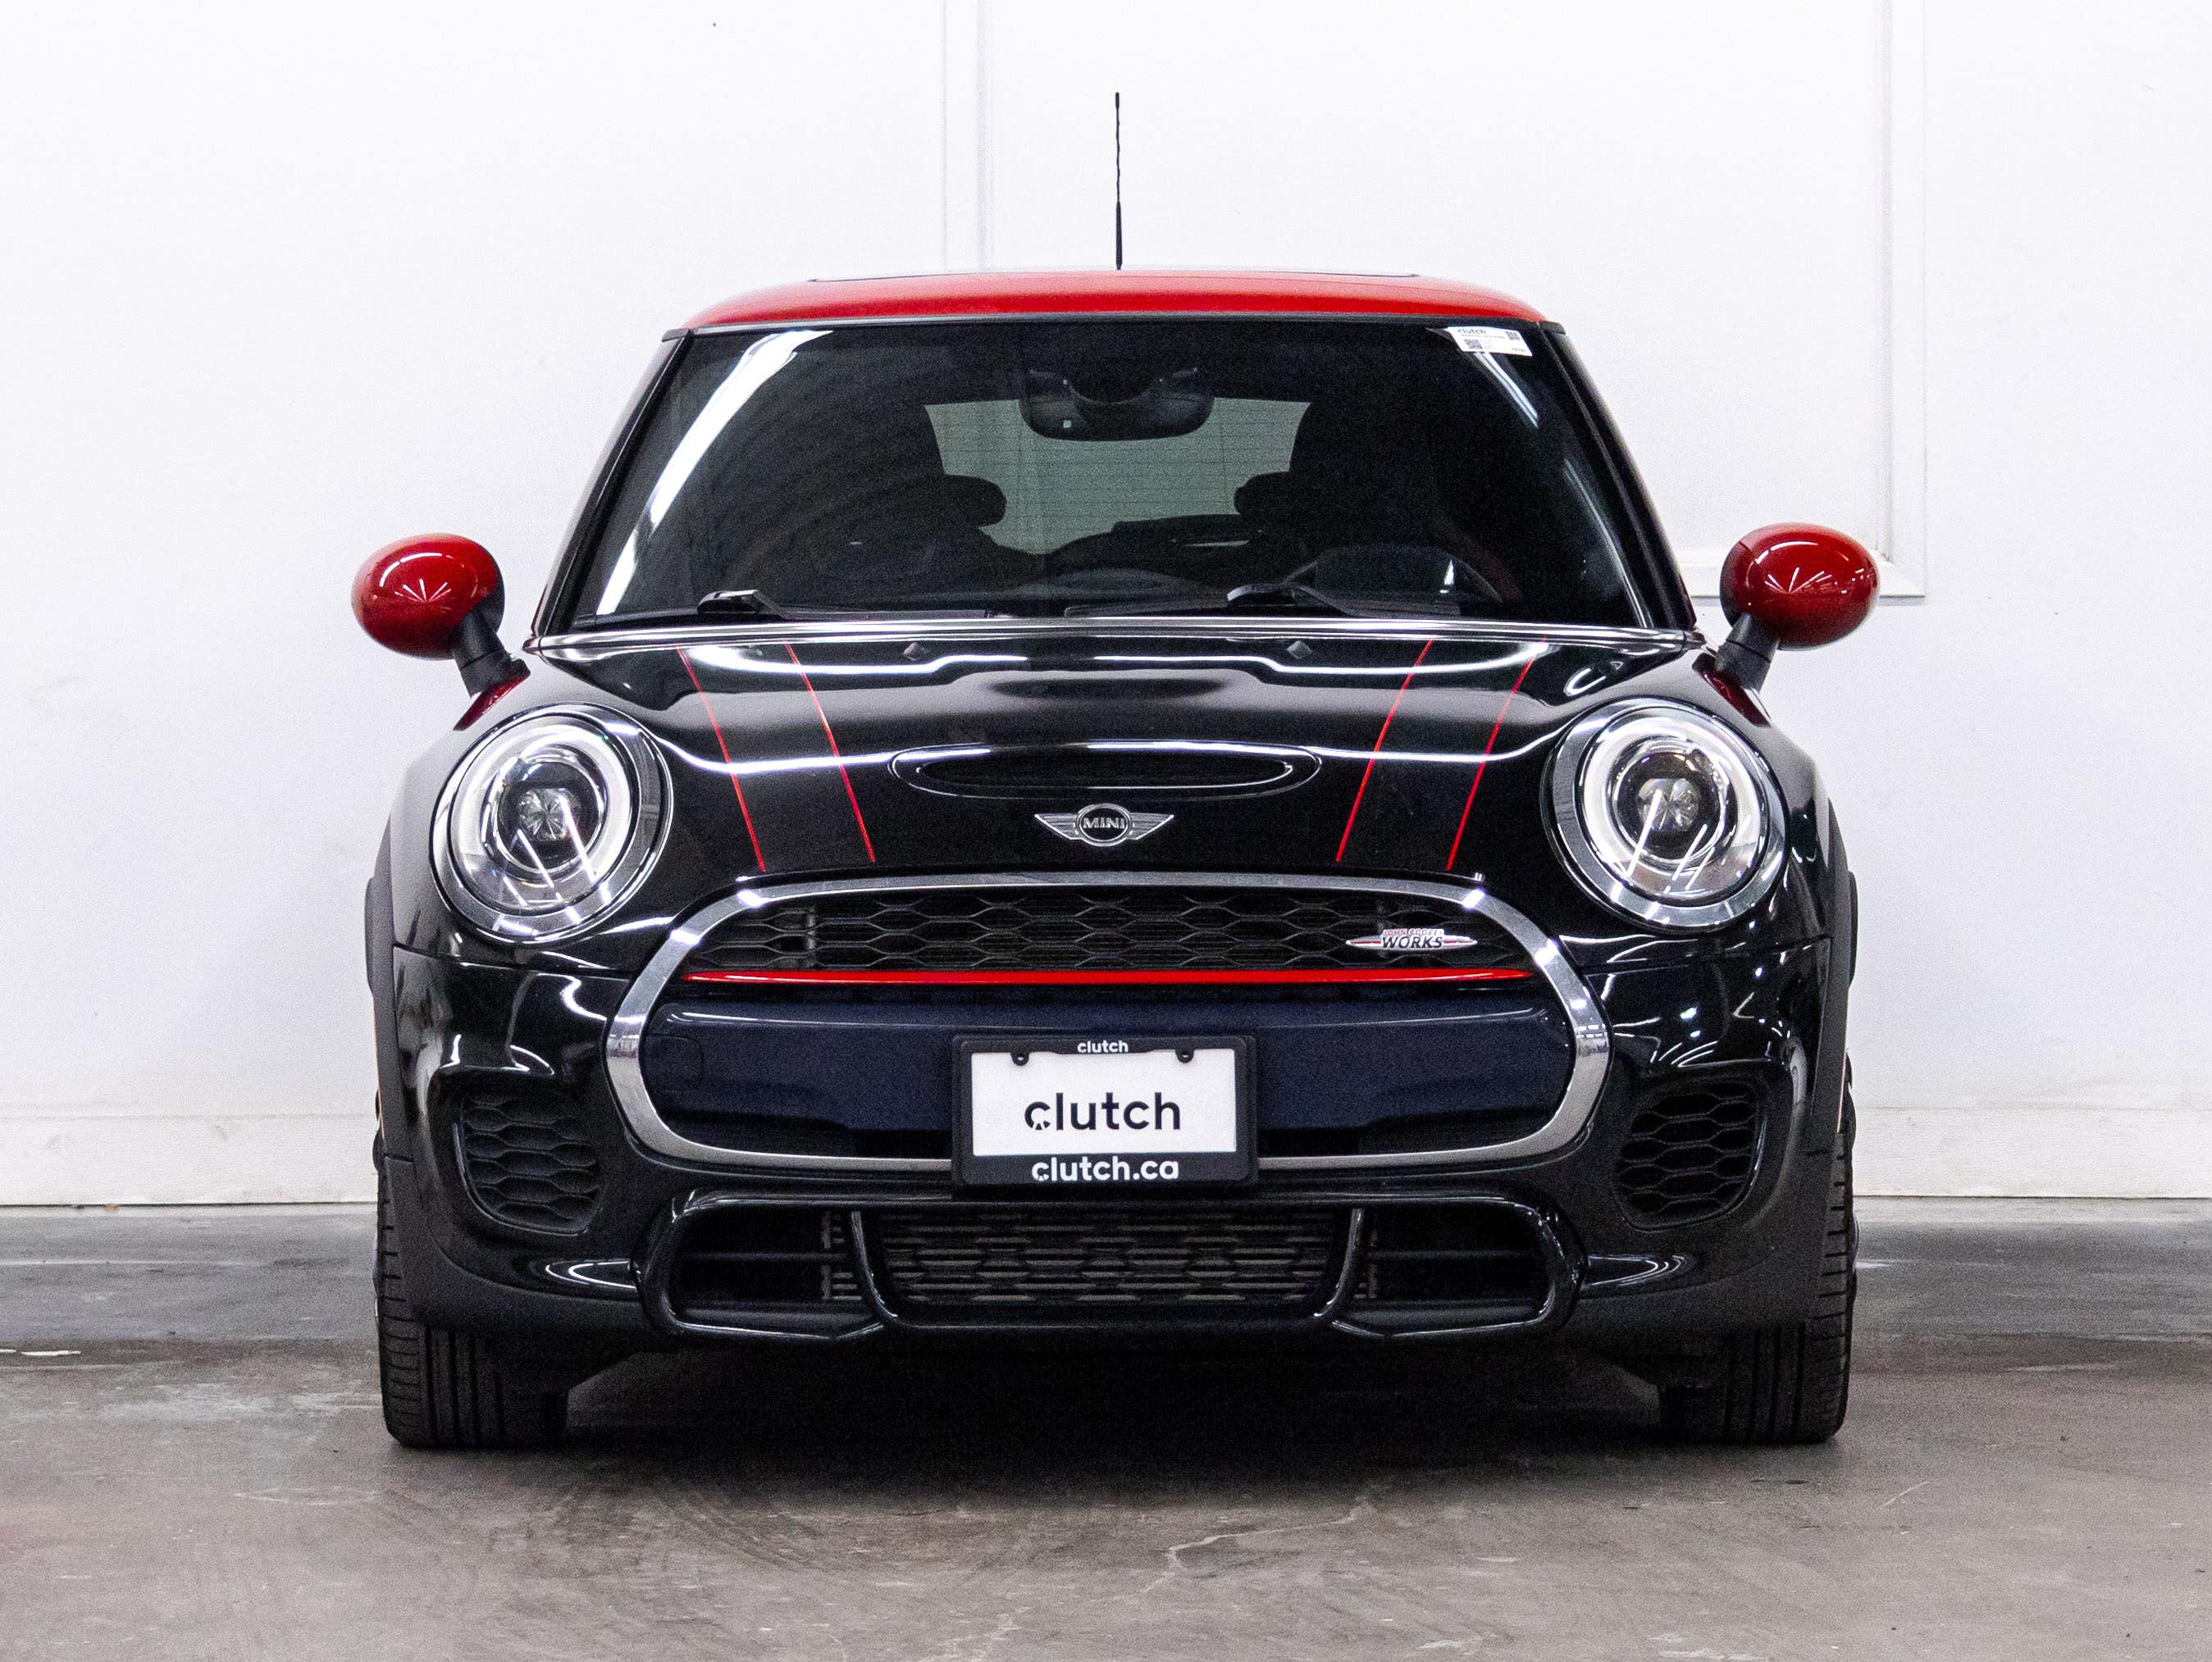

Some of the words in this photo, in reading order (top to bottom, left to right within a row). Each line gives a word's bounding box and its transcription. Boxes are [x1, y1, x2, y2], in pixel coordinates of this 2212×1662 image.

[1082, 817, 1125, 829] MINI
[1382, 936, 1443, 949] WORKS
[1077, 1040, 1129, 1054] clutch
[1024, 1092, 1180, 1131] clutch
[1031, 1156, 1179, 1182] clutch.ca
